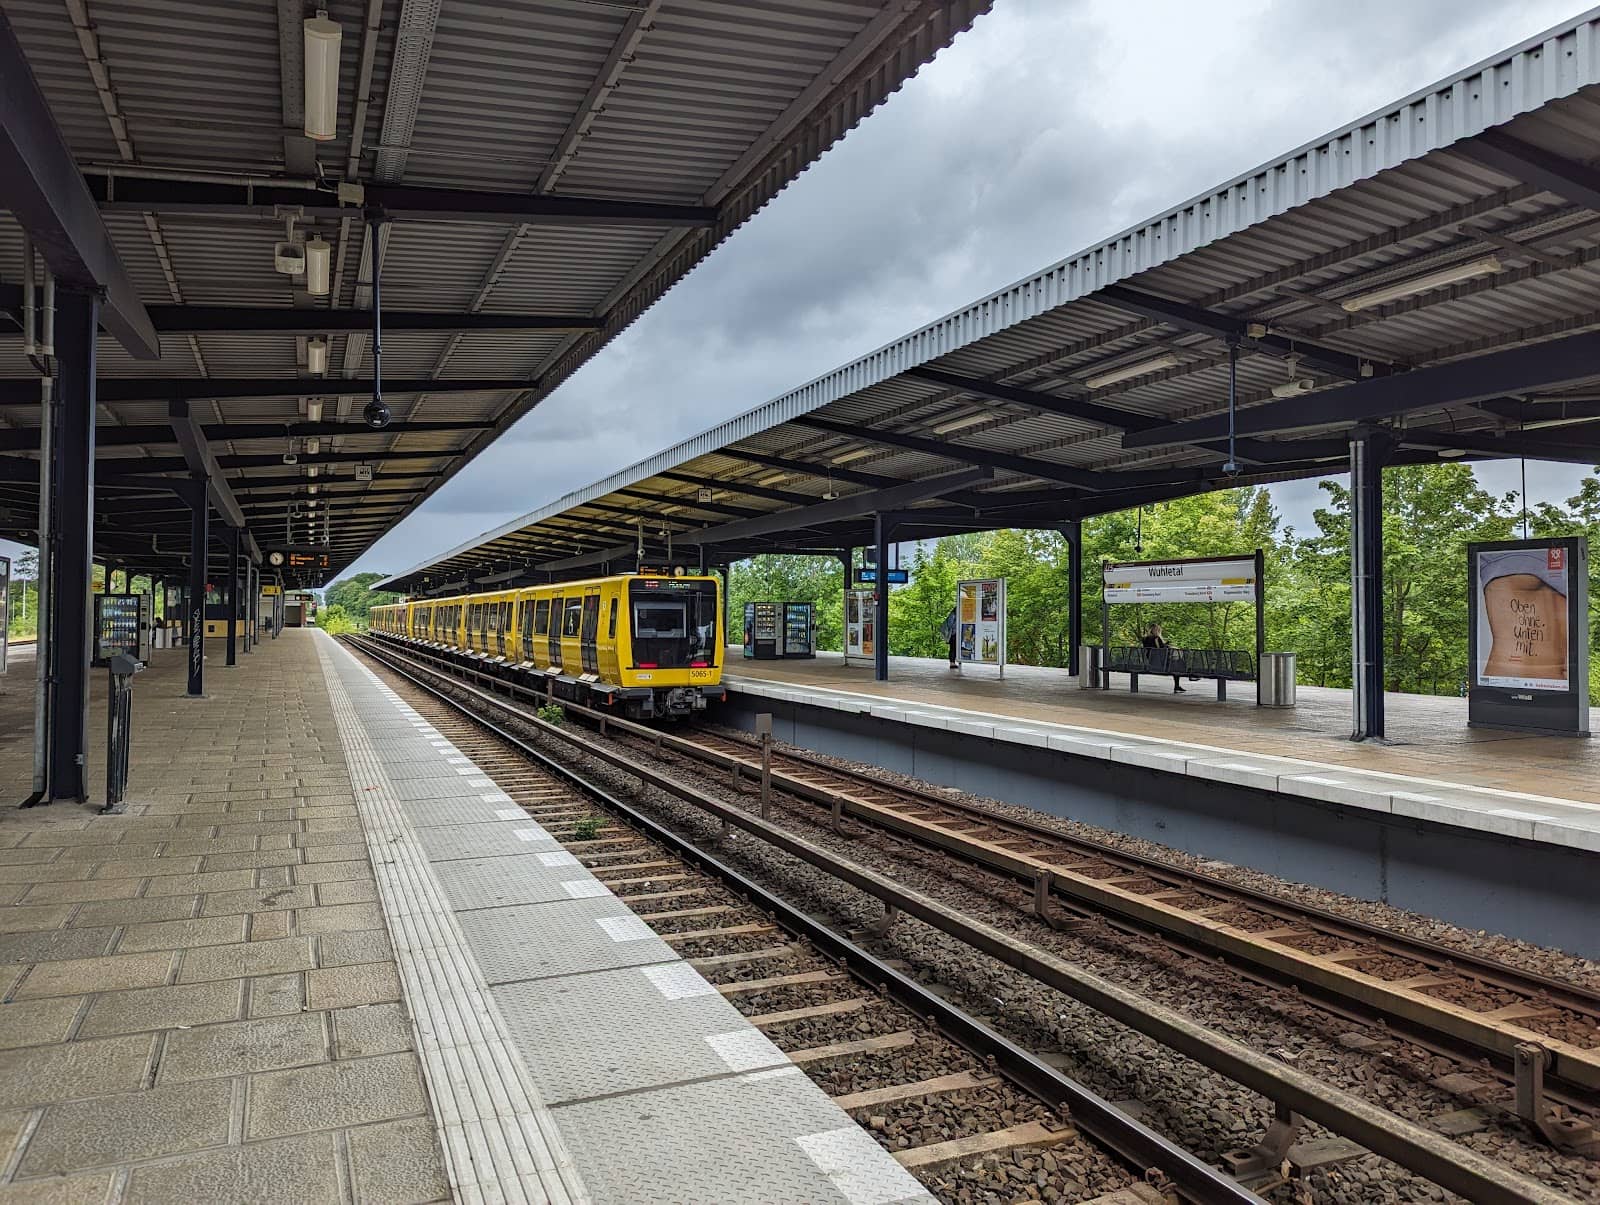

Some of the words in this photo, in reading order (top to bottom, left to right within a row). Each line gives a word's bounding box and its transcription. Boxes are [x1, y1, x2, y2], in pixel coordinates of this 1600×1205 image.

[1148, 565, 1184, 577] Wuhletal
[1510, 598, 1536, 615] Oben
[1519, 614, 1545, 628] ohne.
[1513, 625, 1544, 641] Unten
[1516, 640, 1538, 656] mit.
